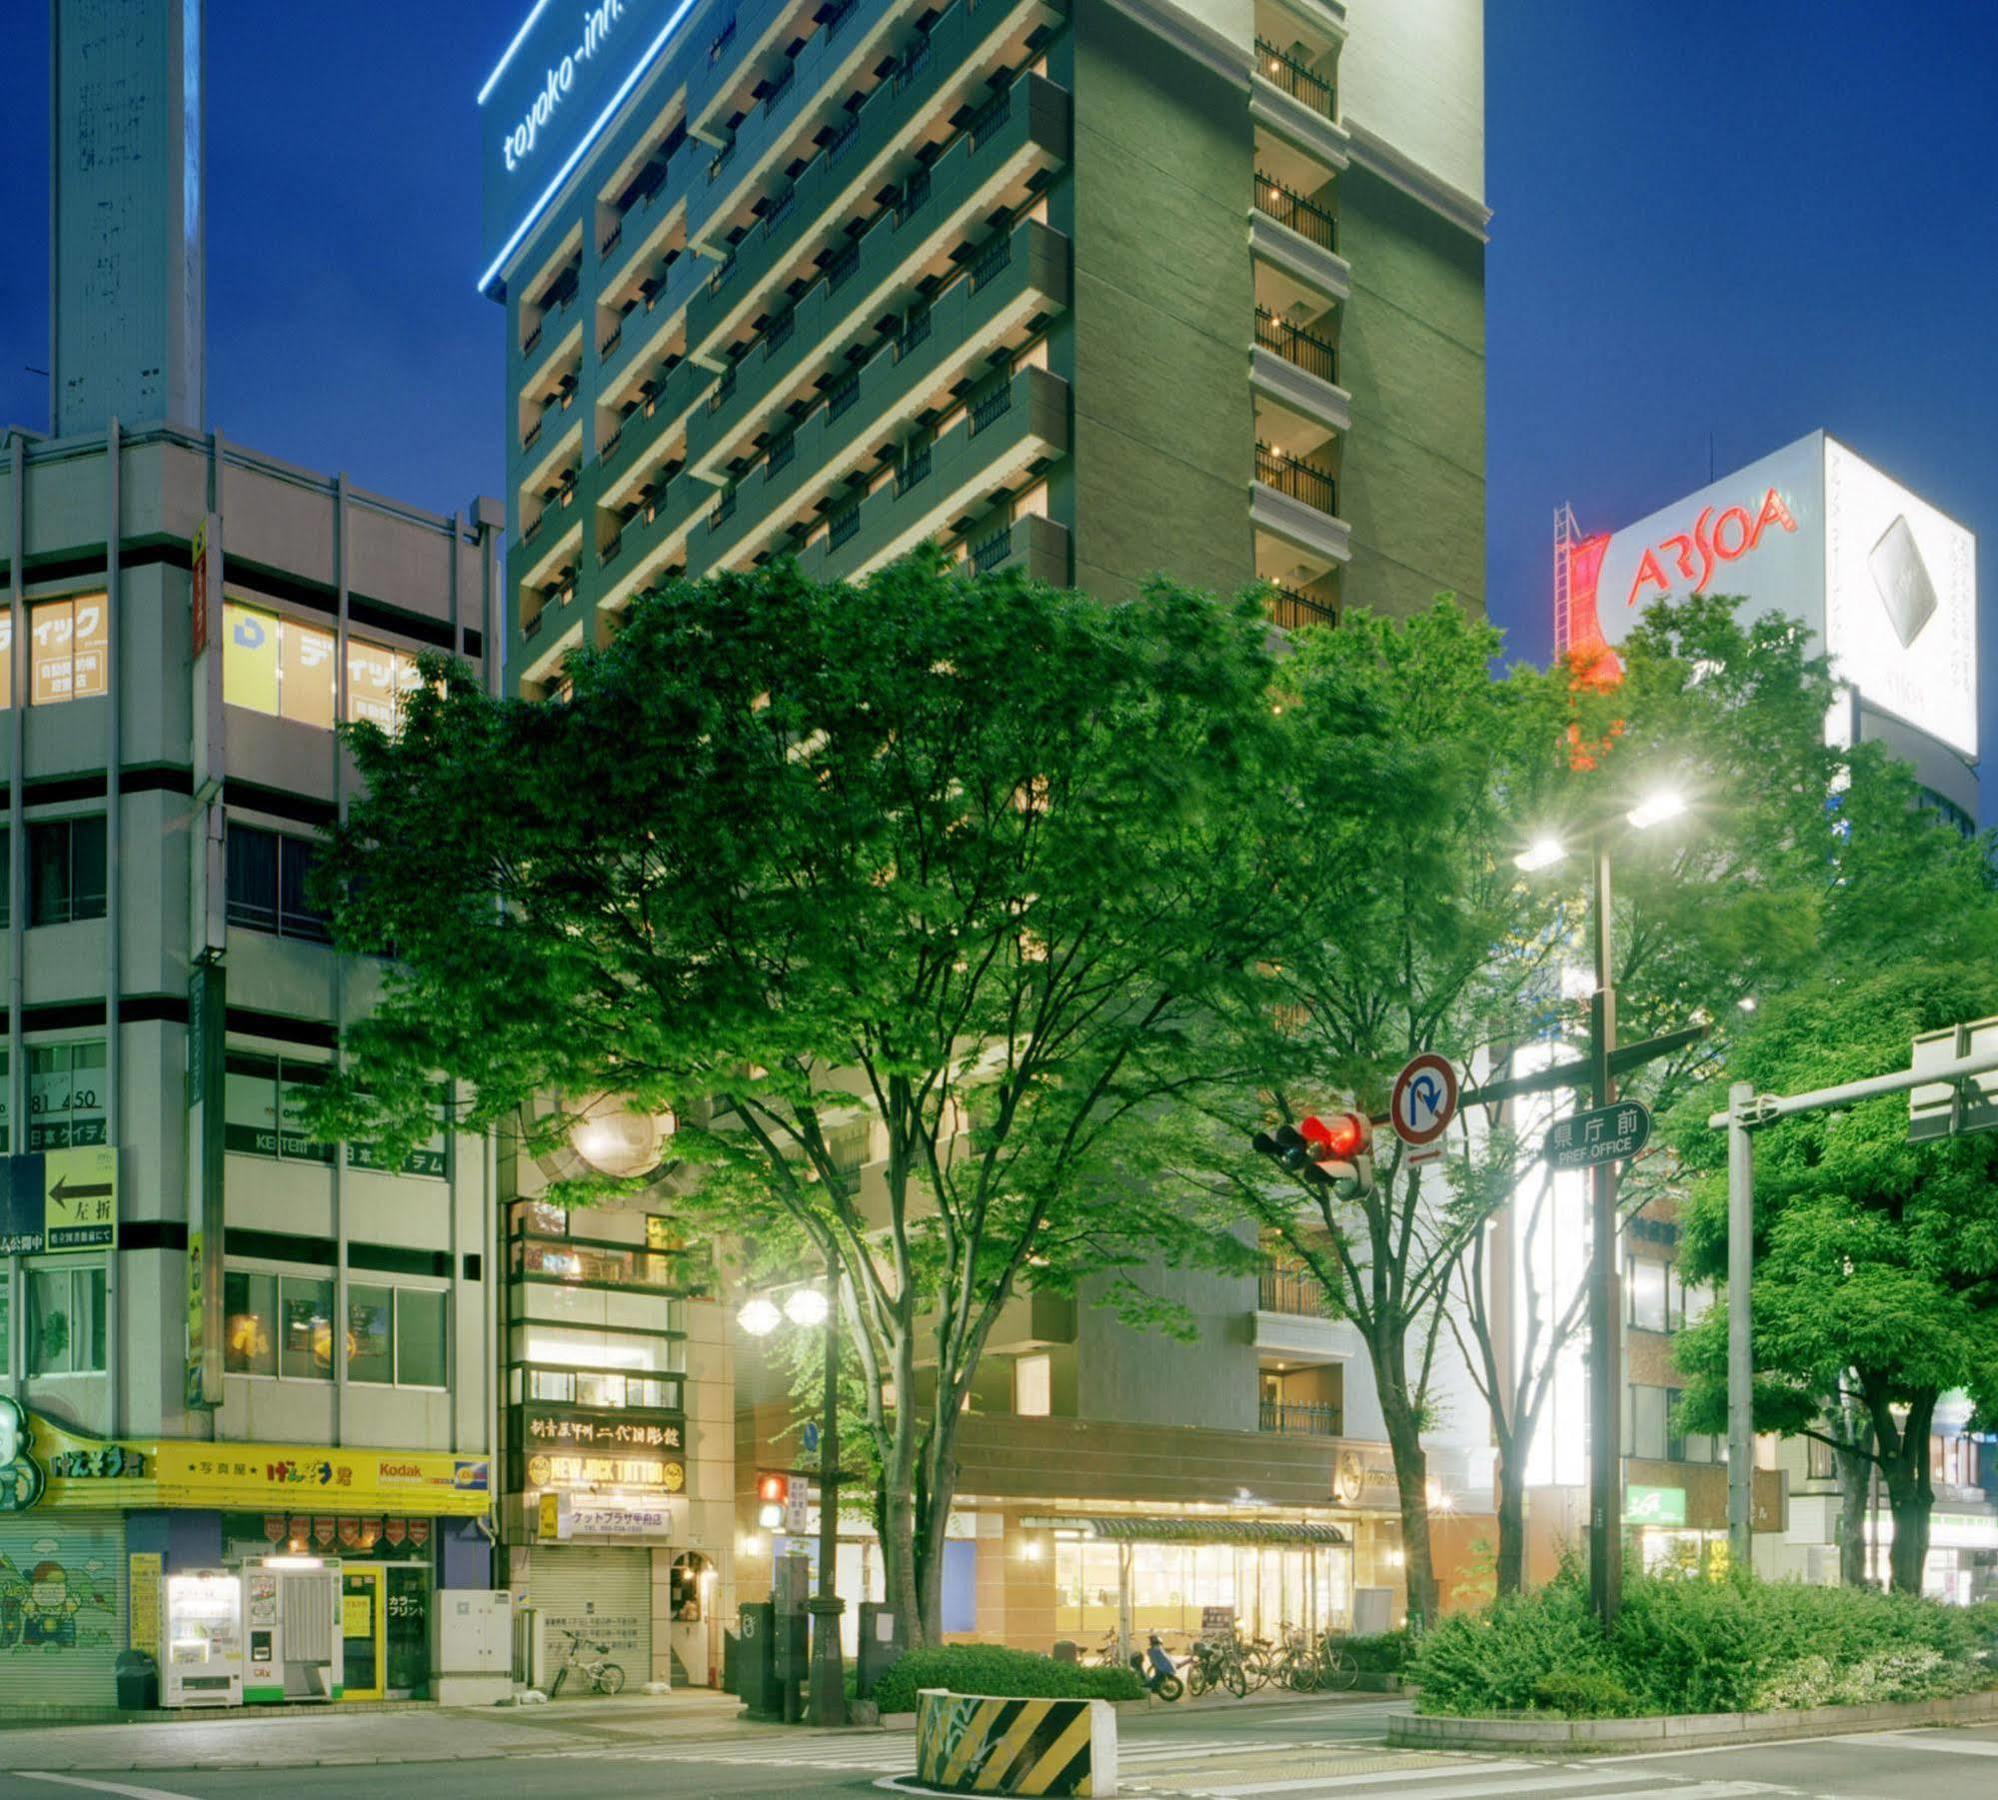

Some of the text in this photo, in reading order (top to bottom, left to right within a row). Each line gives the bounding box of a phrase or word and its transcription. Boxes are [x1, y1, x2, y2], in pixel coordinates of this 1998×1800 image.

[1627, 487, 1798, 607] ARSOA
[1554, 1108, 1638, 1150] 県庁前
[1591, 1136, 1633, 1158] OFFICE
[75, 1200, 111, 1221] 左折
[380, 1463, 422, 1477] Kodak
[389, 1595, 418, 1606] カラー
